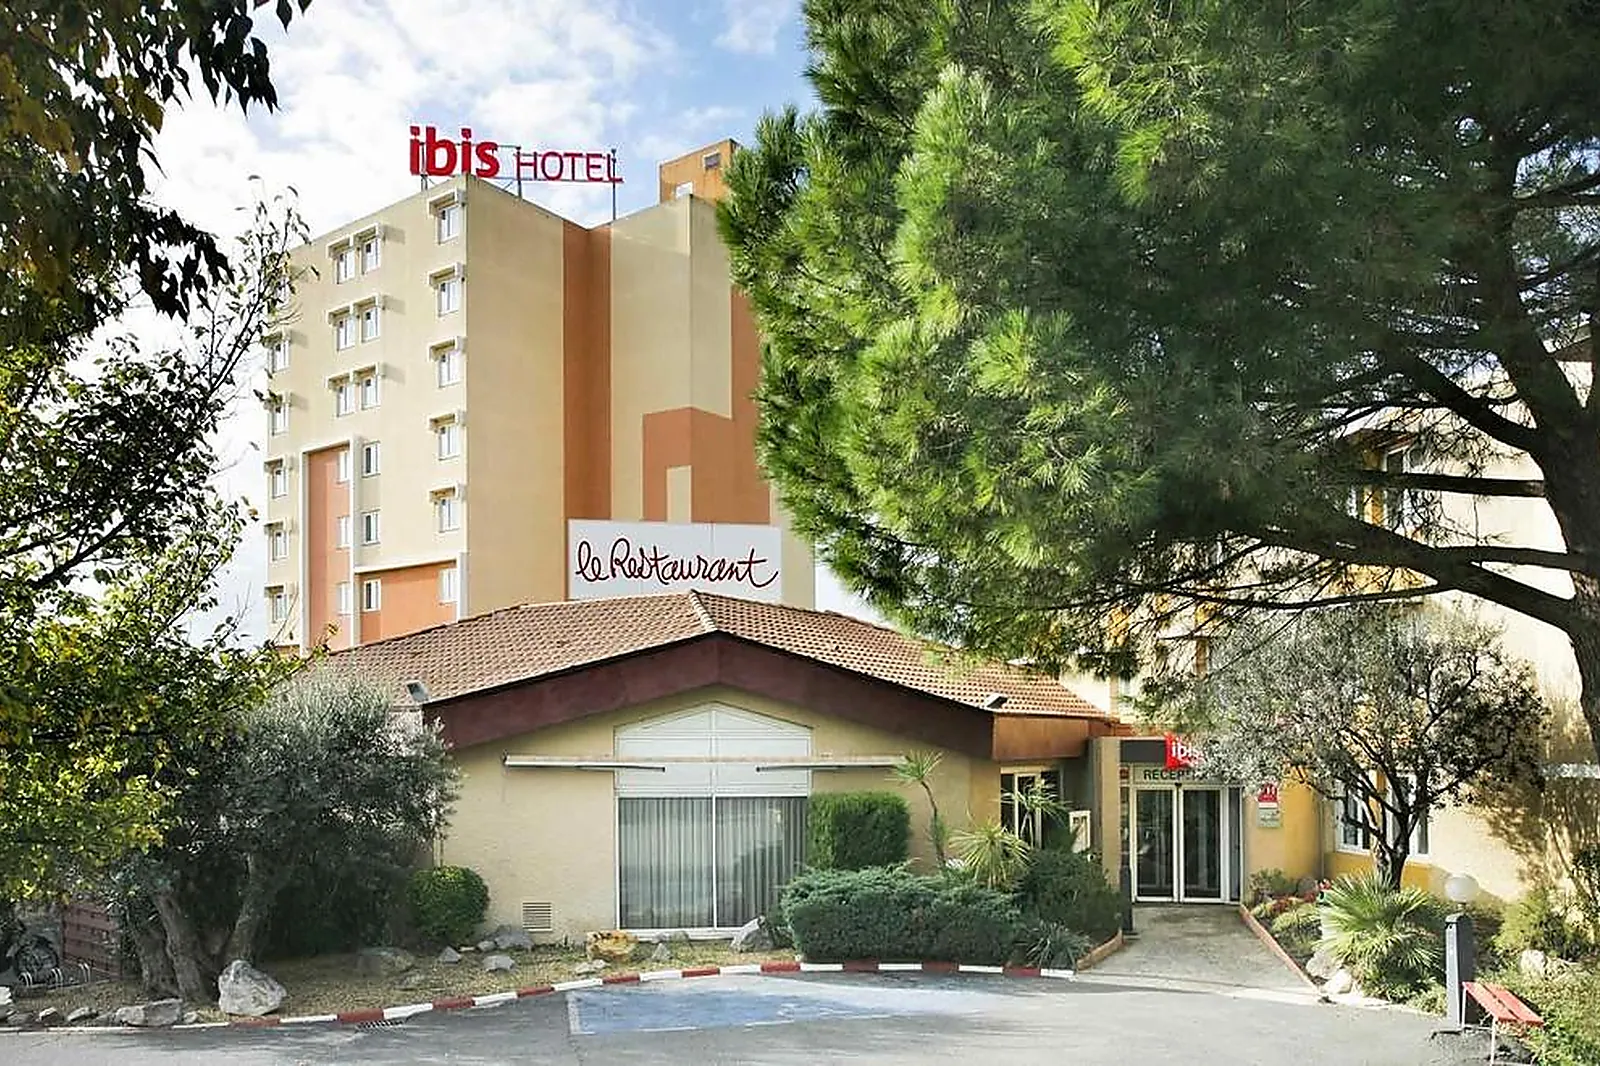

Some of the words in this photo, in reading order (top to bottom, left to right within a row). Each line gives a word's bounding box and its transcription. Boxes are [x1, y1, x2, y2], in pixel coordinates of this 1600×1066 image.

[409, 125, 500, 178] ibis
[515, 151, 624, 183] HOTEL
[575, 540, 609, 582] le
[611, 537, 778, 588] Restaurant
